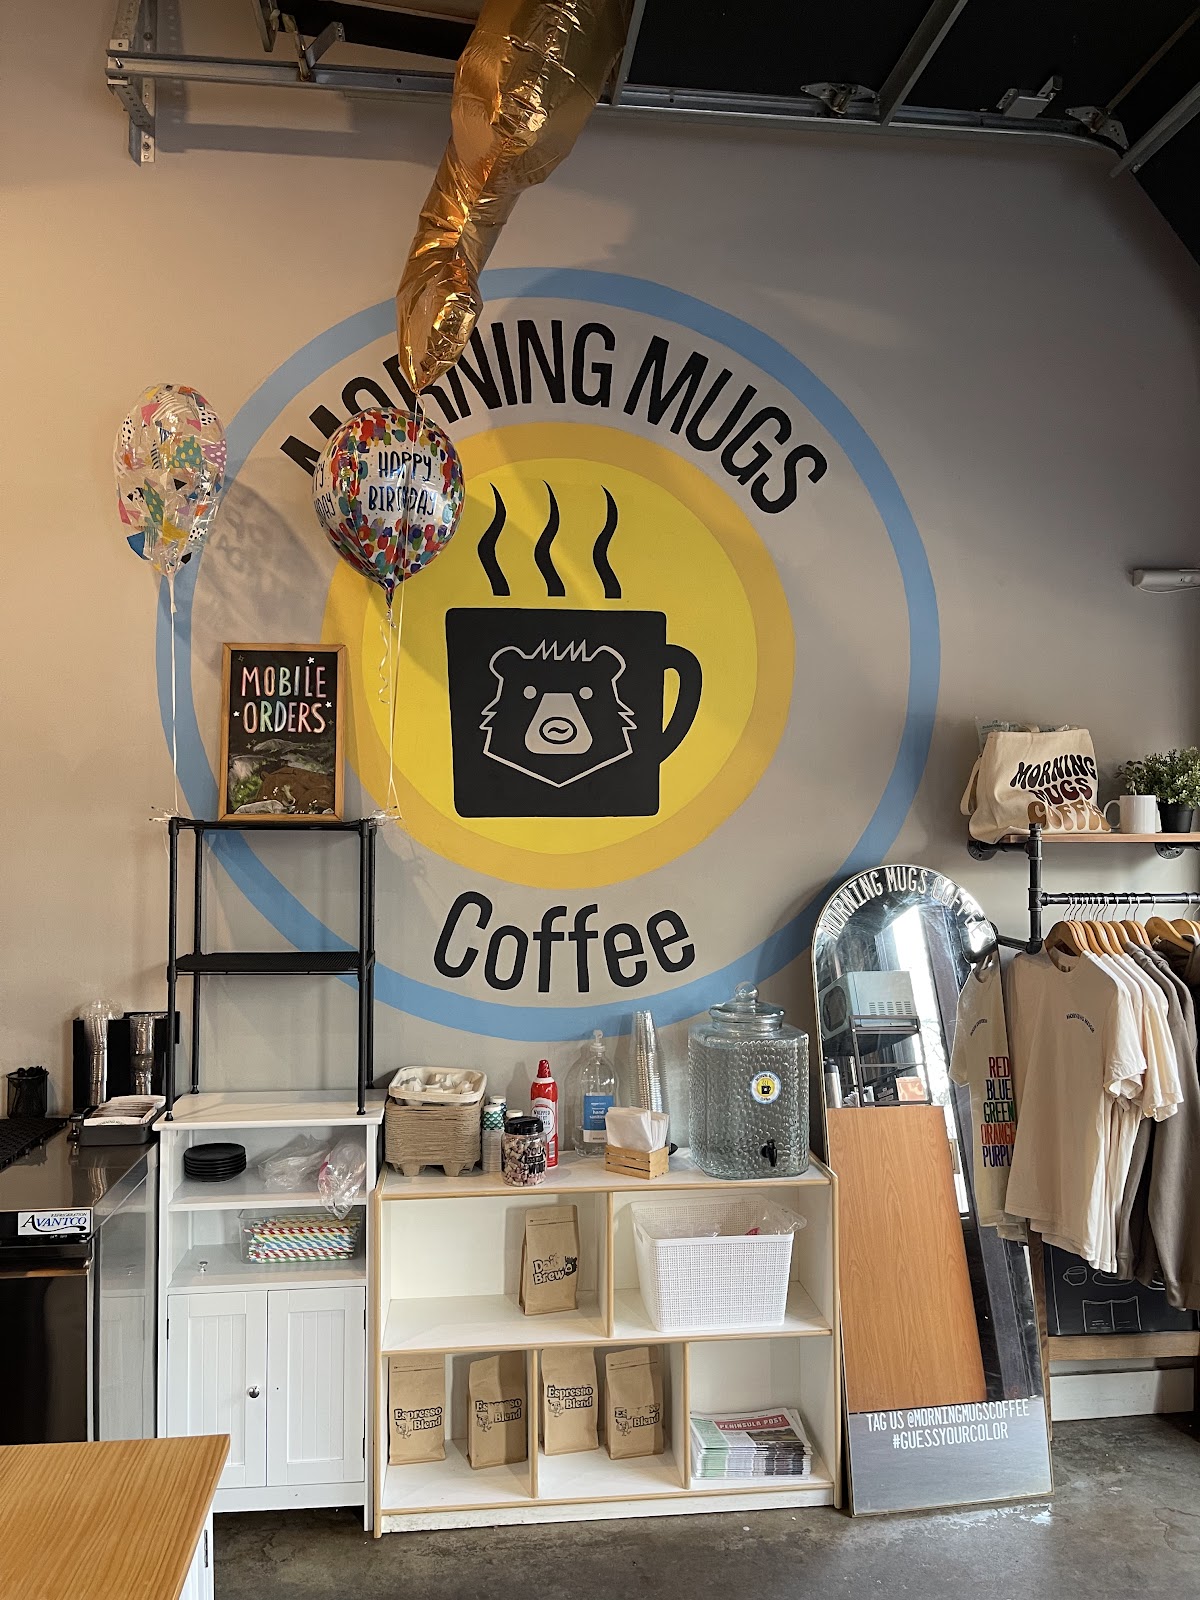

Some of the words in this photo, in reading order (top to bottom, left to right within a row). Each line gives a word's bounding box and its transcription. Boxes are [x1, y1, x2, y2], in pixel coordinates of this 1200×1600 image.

[624, 335, 827, 514] MUGS
[378, 450, 432, 481] HAPPY
[241, 665, 327, 698] MOBILE
[243, 700, 326, 733] ORDERS
[1009, 754, 1098, 790] MORNING
[1028, 777, 1093, 807] MUGS
[819, 871, 884, 940] MORNING
[885, 866, 928, 894] MUGS
[433, 890, 696, 993] Coffee
[988, 1056, 1011, 1079] RED
[985, 1079, 1013, 1100] BLUE
[983, 1101, 1015, 1123] GREEN
[982, 1145, 1014, 1168] PURPL
[21, 1214, 87, 1233] AVANTCO
[533, 1270, 565, 1286] Brew
[394, 1406, 442, 1422] Espresso
[475, 1398, 523, 1414] Esso
[565, 1396, 593, 1410] Blend
[614, 1403, 661, 1420] Esso
[413, 1415, 442, 1431] Blend
[494, 1408, 522, 1424] Blend
[633, 1412, 660, 1428] Blend
[719, 1420, 762, 1430] PENINSULA
[763, 1416, 784, 1426] POST
[866, 1412, 887, 1433] TAG
[889, 1411, 904, 1431] US
[907, 1398, 1030, 1429] @MORNINGMUGSCOFFEE
[892, 1421, 1009, 1450] #GUESSYOURCOLOR
